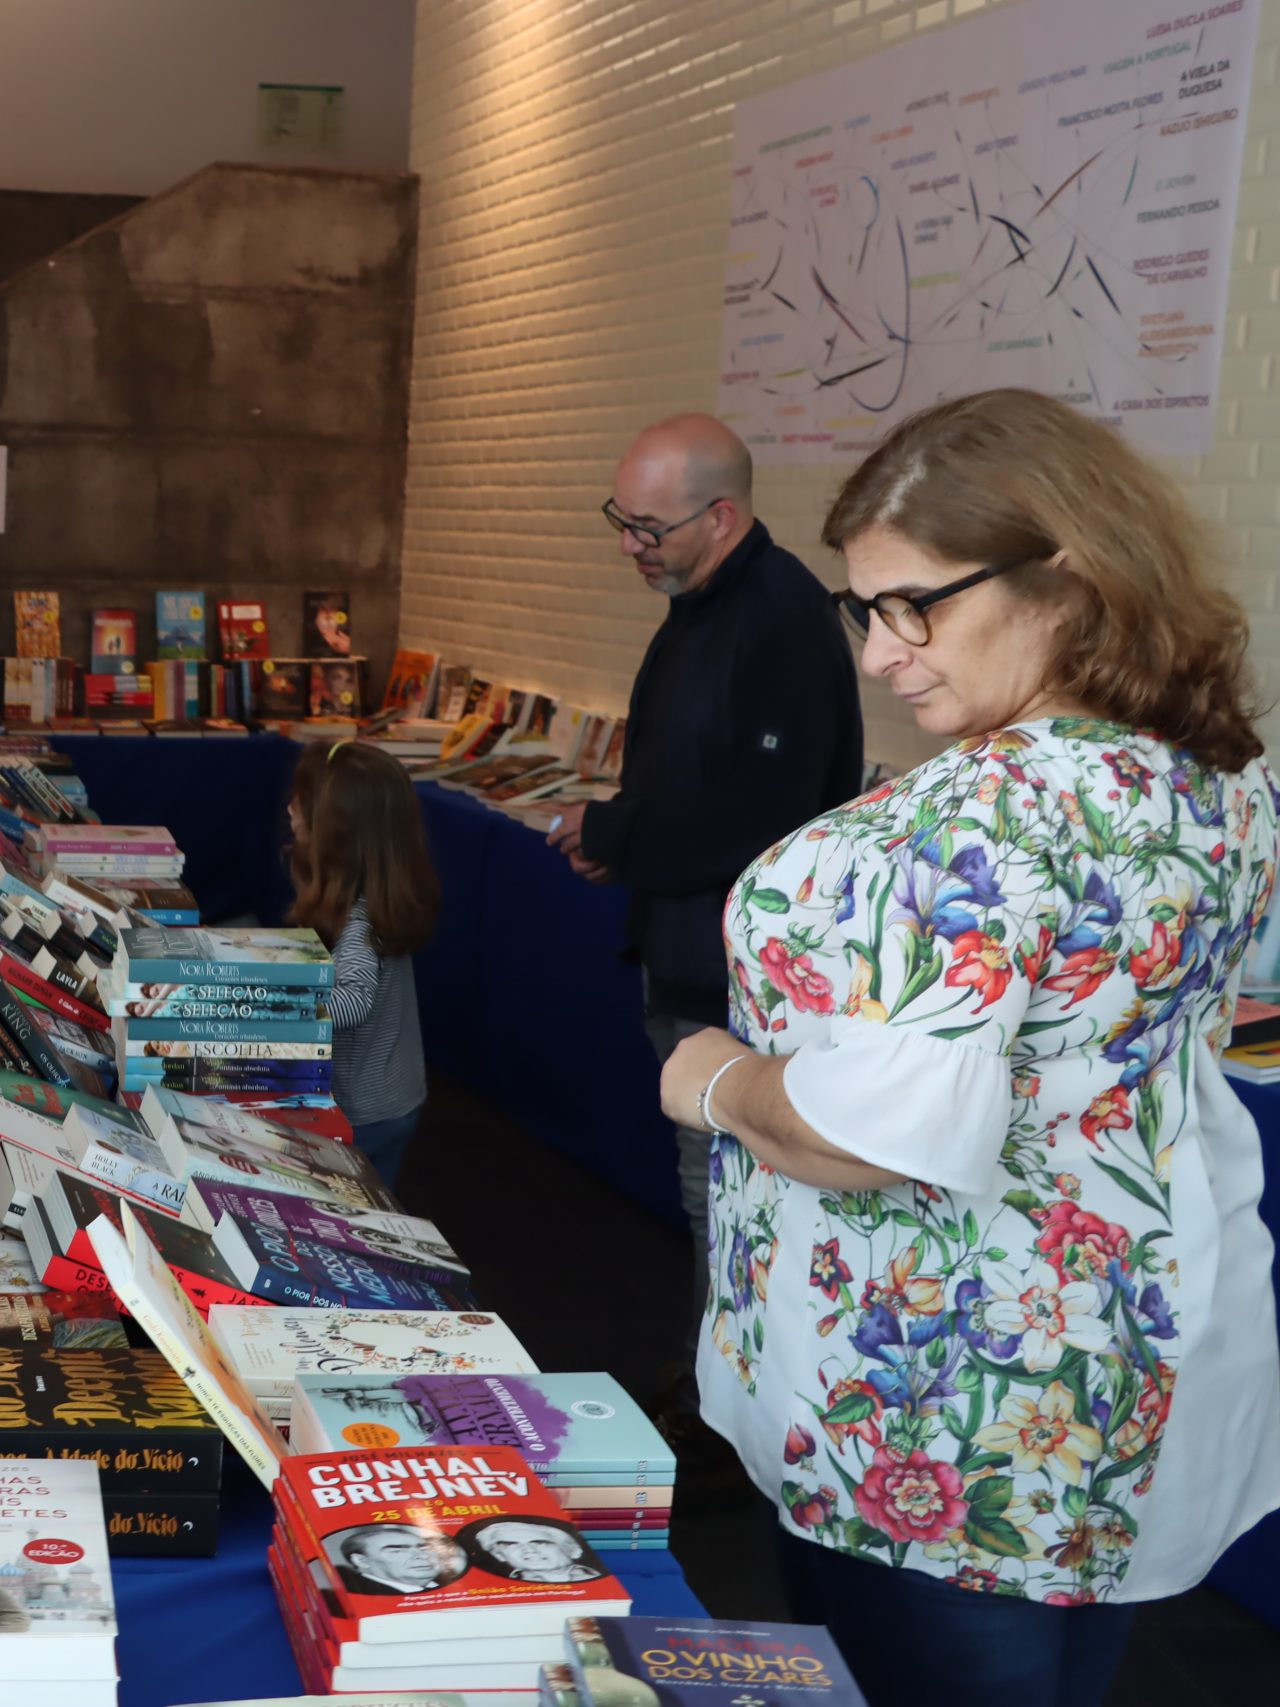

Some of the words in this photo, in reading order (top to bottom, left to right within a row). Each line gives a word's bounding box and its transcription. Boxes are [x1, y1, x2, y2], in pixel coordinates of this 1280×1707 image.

[1180, 72, 1188, 83] A
[1188, 63, 1217, 80] VIELA
[1217, 59, 1232, 73] DA
[1178, 79, 1223, 100] DUQUESA
[1058, 108, 1103, 128] FRANCISCO
[1192, 108, 1240, 129] ISHIGURO
[1137, 204, 1186, 223] FERNANDO
[1186, 199, 1221, 215] PESSOA
[1133, 254, 1174, 271] RODRIGO
[1161, 266, 1209, 284] CARVALHO
[179, 961, 205, 976] NORA
[206, 961, 240, 976] ROBERTS
[55, 970, 78, 991] LAYLA
[198, 985, 268, 1002] SELEÇÃO
[183, 1002, 253, 1019] SELEÇÃO
[1, 1002, 32, 1041] KING
[179, 1020, 204, 1035] NORA
[206, 1020, 239, 1035] ROBERTS
[193, 1043, 274, 1057] ESCOLHA
[242, 1065, 270, 1073] absoluta
[241, 1083, 269, 1092] absoluta
[91, 1161, 115, 1177] BLACK
[94, 1153, 120, 1168] HOLLY
[161, 1184, 186, 1204] RAI
[252, 1222, 289, 1255] PIOR
[284, 1286, 293, 1295] O
[293, 1288, 310, 1302] PIOR
[313, 1296, 329, 1308] DOS
[280, 1317, 369, 1375] Dalloway
[39, 1349, 136, 1428] Deepti
[484, 1377, 543, 1440] ACONTECIMENTO
[195, 1382, 213, 1406] NUNCA
[237, 1437, 251, 1453] DAS
[247, 1448, 267, 1472] FLORES
[340, 1452, 380, 1463] JOSÉ
[385, 1448, 469, 1460] MILHAZES
[531, 1438, 547, 1453] O
[114, 1449, 138, 1473] do
[136, 1449, 184, 1473] Vício
[307, 1456, 517, 1488] CUNHAL,
[309, 1476, 529, 1509] BREJNEV
[372, 1509, 401, 1522] 25
[406, 1507, 436, 1519] DE
[441, 1503, 509, 1517] ABRIL
[434, 1499, 445, 1507] O
[109, 1512, 132, 1536] do
[132, 1512, 179, 1537] Vício
[28, 1549, 80, 1560] EDIÇÃO
[510, 1583, 573, 1593] Soviética
[641, 1649, 678, 1666] O
[680, 1651, 824, 1673] VINHO
[648, 1665, 713, 1681] DOS
[720, 1668, 833, 1687] CZARES
